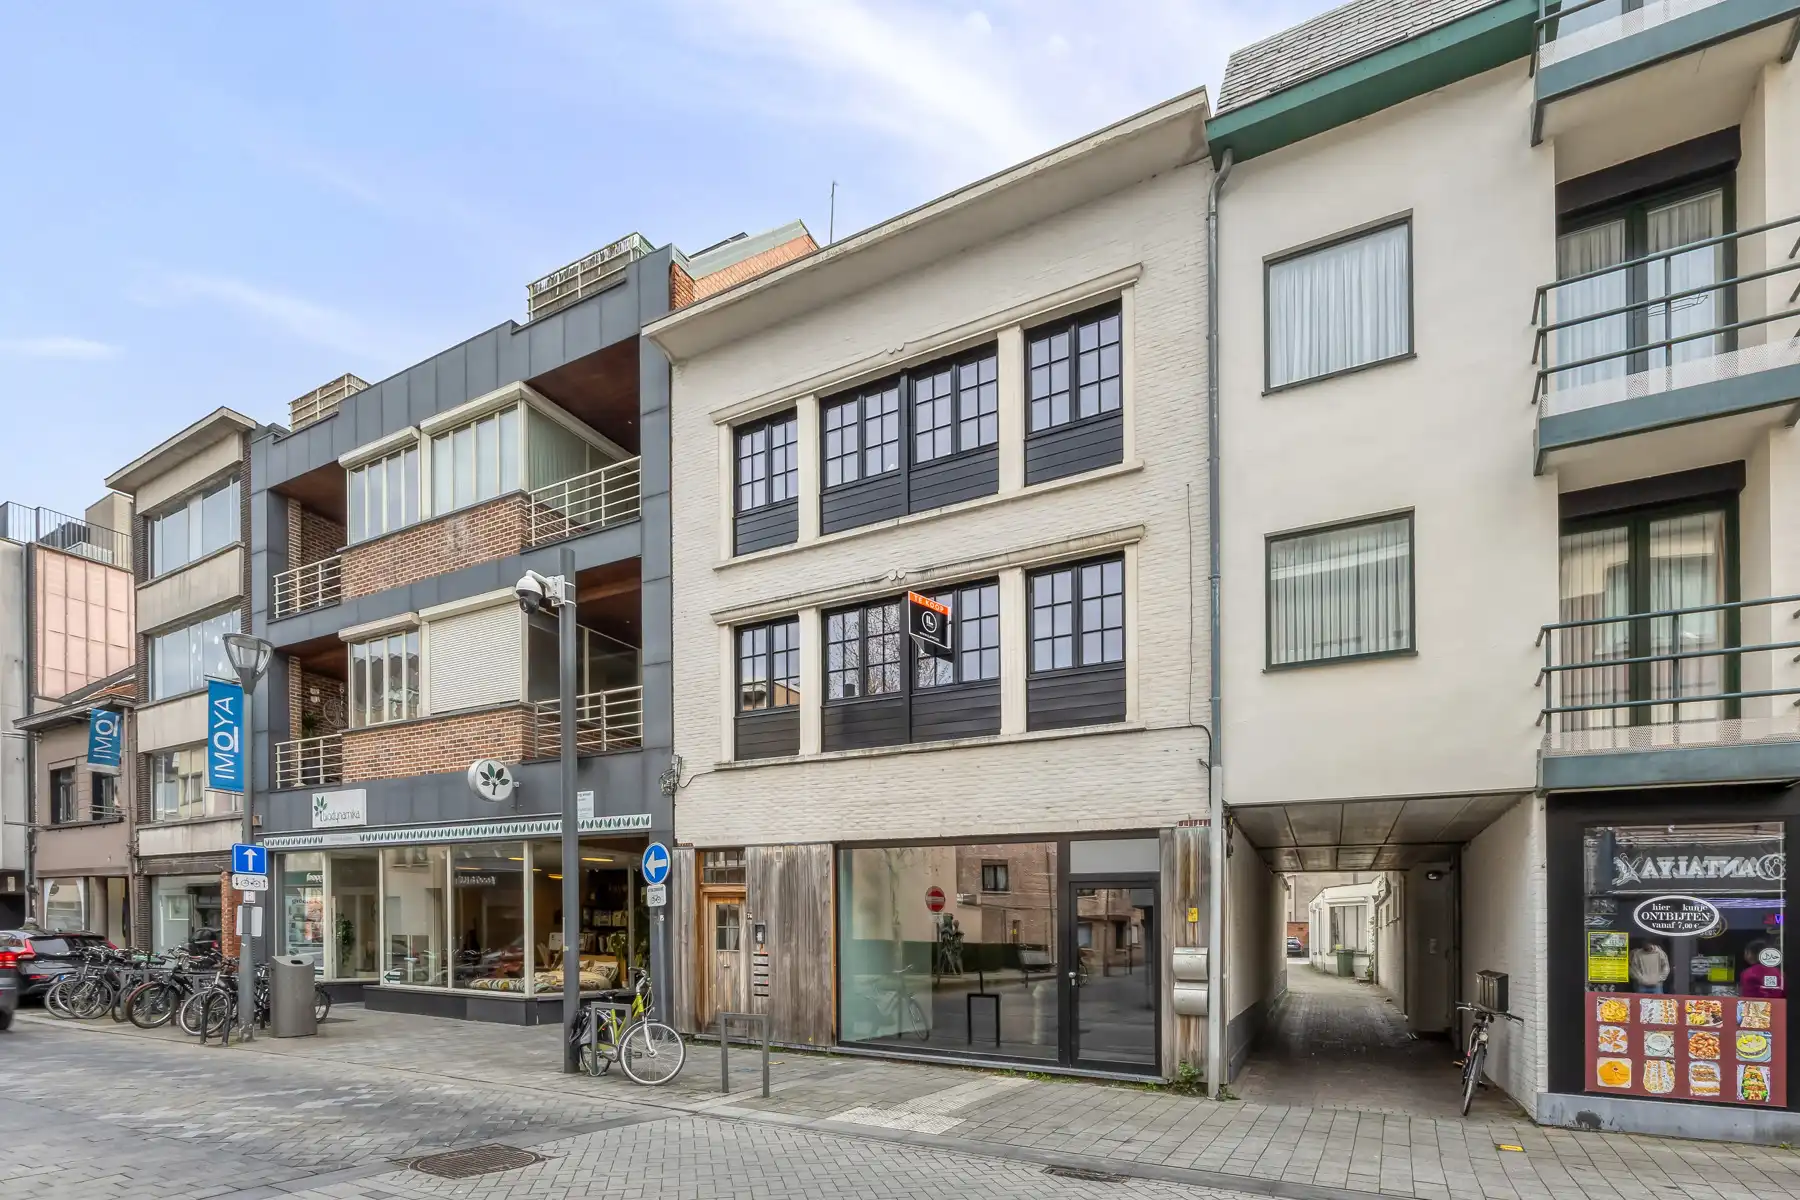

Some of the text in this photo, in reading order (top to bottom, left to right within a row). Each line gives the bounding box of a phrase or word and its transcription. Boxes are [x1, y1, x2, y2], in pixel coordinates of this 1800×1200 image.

[914, 594, 944, 611] TE KOOP
[93, 710, 119, 759] IMO
[214, 697, 239, 780] IMOYA
[1641, 911, 1710, 921] ONTBIJTEN
[1651, 921, 1676, 929] vanaf
[1677, 921, 1693, 930] 7,00
